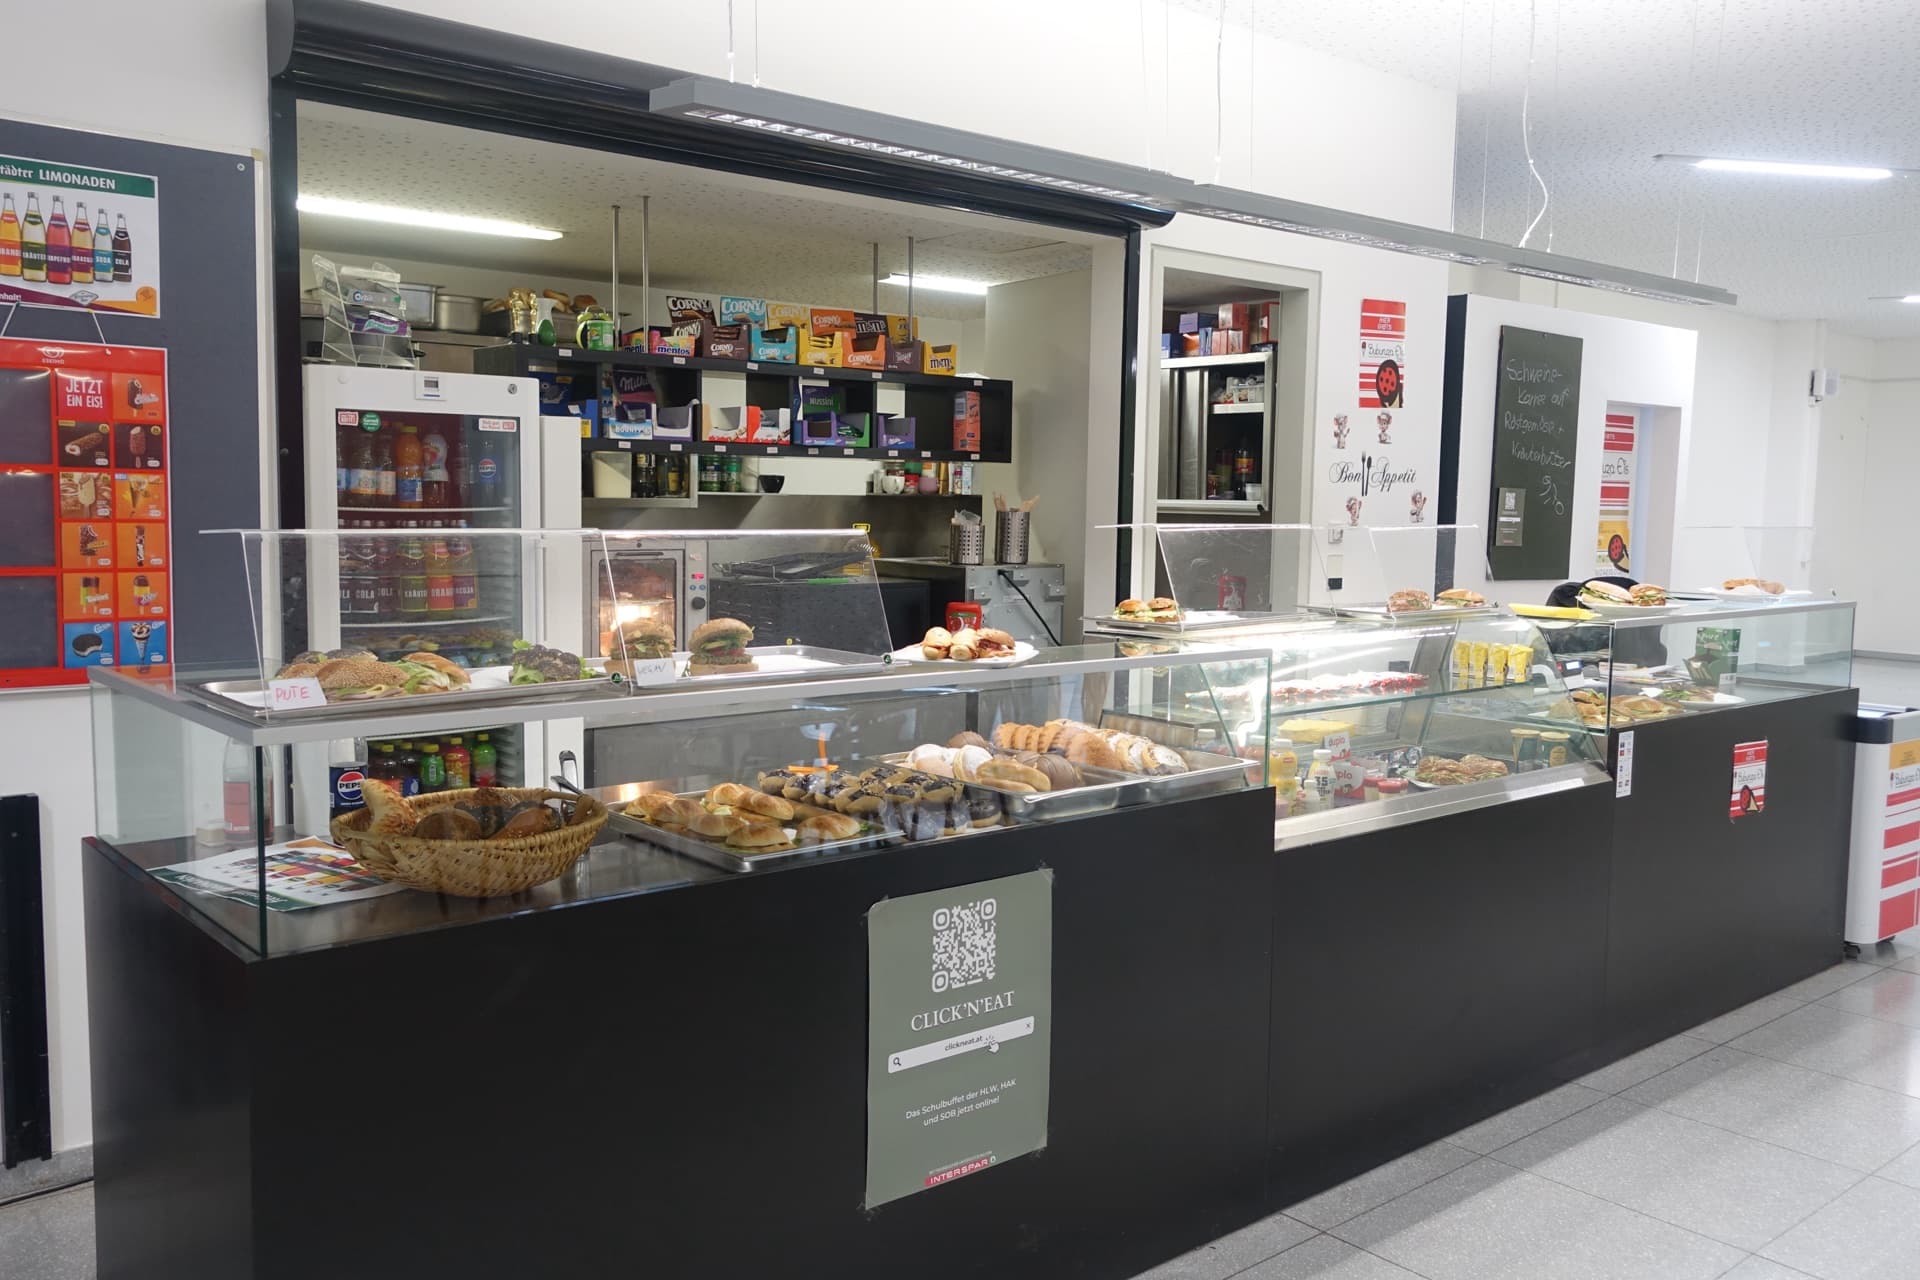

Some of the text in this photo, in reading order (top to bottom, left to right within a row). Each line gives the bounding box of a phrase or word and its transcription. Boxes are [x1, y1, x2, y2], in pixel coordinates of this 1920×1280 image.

[39, 168, 116, 190] LIMONADEN
[115, 257, 129, 265] COLA
[667, 297, 713, 313] CORNY
[721, 299, 766, 314] CORNY
[657, 346, 691, 355] mentos
[710, 343, 734, 352] CORNY
[66, 379, 103, 394] JETZT
[1329, 457, 1416, 492] Bon Appetit
[275, 685, 311, 703] PUTE
[1328, 735, 1346, 746] duplo
[944, 1035, 983, 1052] clickneat.at
[905, 1078, 1017, 1120] Das Schulbuffet der HLW, HAK
[923, 1095, 1001, 1127] und SOB jetzt online!
[930, 1158, 990, 1184] INTERSPAR
